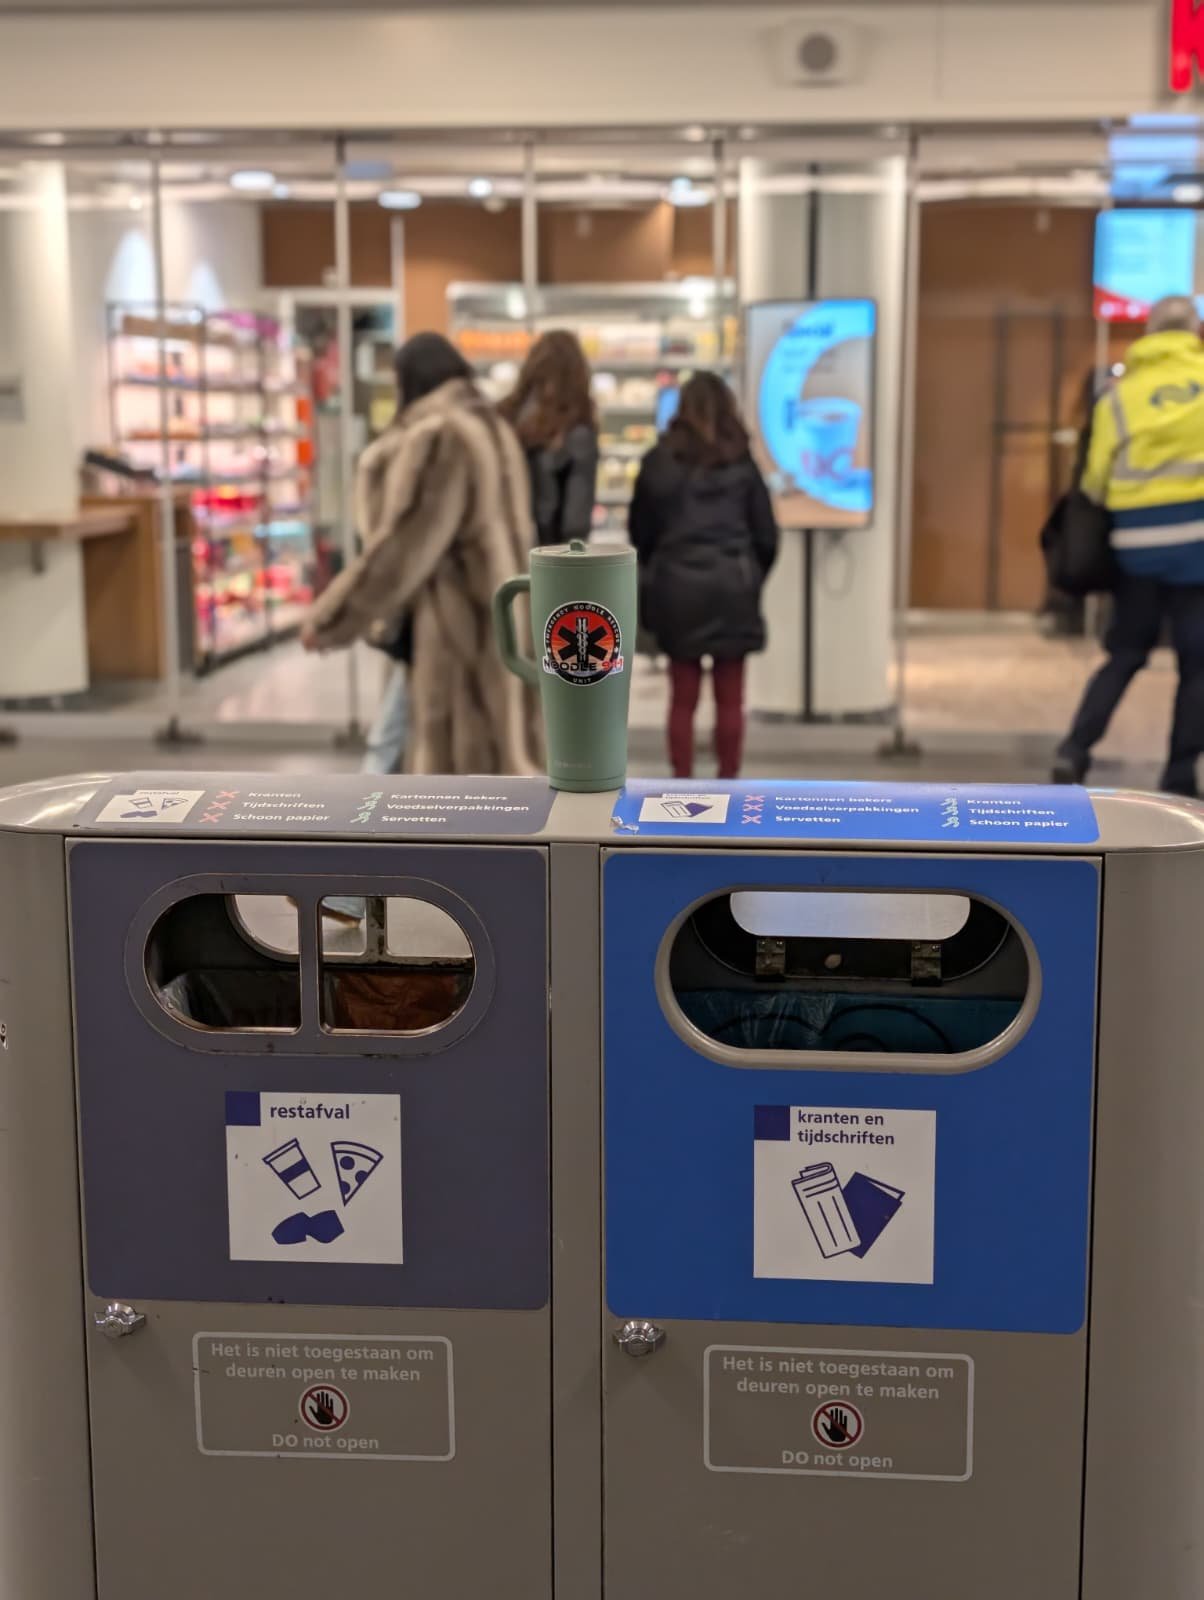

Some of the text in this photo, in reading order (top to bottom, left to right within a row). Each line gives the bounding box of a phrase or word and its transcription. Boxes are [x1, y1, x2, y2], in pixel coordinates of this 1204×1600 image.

[573, 605, 605, 616] NOODLE
[543, 657, 597, 672] NOODLE
[248, 791, 301, 799] Kranten
[242, 801, 326, 810] Tijdschriften
[386, 803, 530, 813] Voedselverpakkingen
[775, 804, 920, 814] Voedselverpakkingen
[969, 808, 1055, 816] Tijdschriften
[232, 813, 330, 823] Schoon papier
[381, 815, 448, 823] Servetten
[775, 815, 841, 823] Servetten
[969, 819, 1069, 828] Schoon papier
[270, 1103, 350, 1120] restafval
[798, 1110, 885, 1126] kranten en
[797, 1128, 895, 1146] tijdschriften
[211, 1343, 435, 1362] Het is niet toegestaan om
[225, 1363, 421, 1383] deuren open te maken
[723, 1356, 955, 1379] Het is niet toegestaan om
[736, 1377, 940, 1400] deuren open te maken
[272, 1434, 380, 1452] DO not open
[781, 1450, 894, 1470] DO not open
